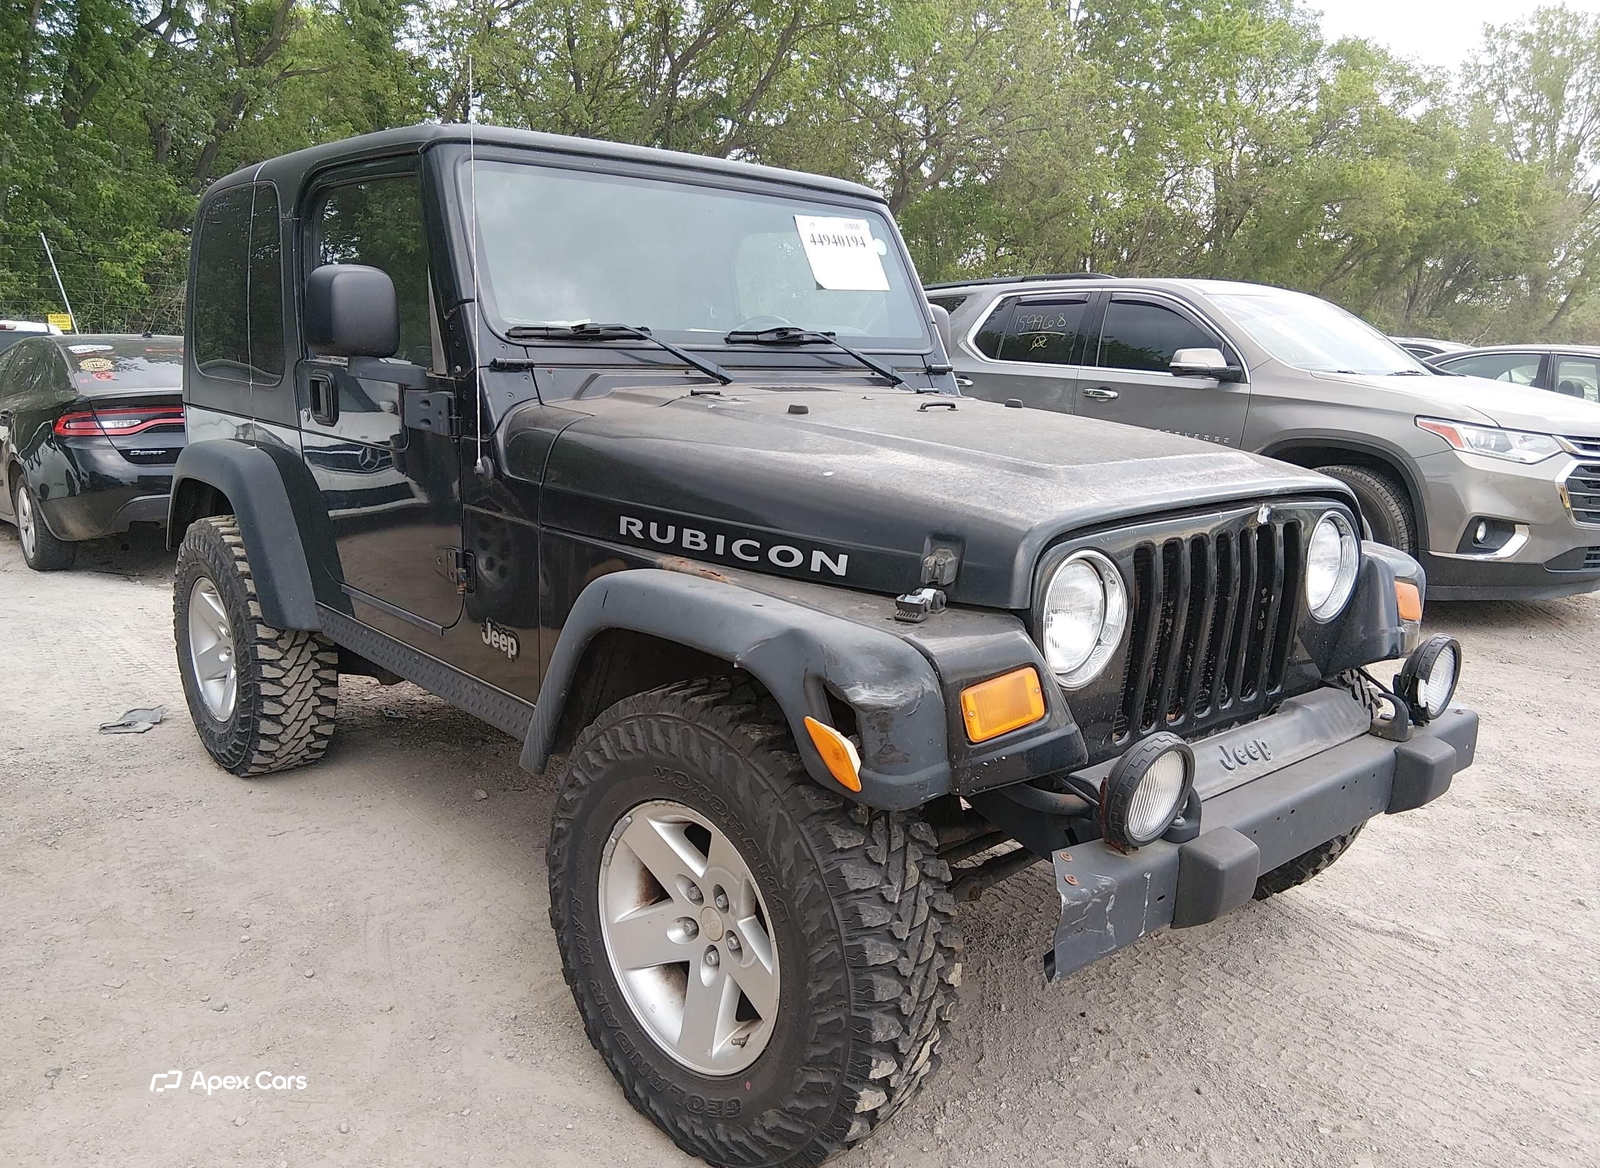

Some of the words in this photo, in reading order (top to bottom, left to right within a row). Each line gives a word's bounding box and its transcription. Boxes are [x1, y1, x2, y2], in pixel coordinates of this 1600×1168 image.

[809, 233, 866, 248] 44940194
[619, 515, 848, 577] RUBICON
[481, 619, 518, 659] Jeep
[1218, 739, 1272, 771] Jeep
